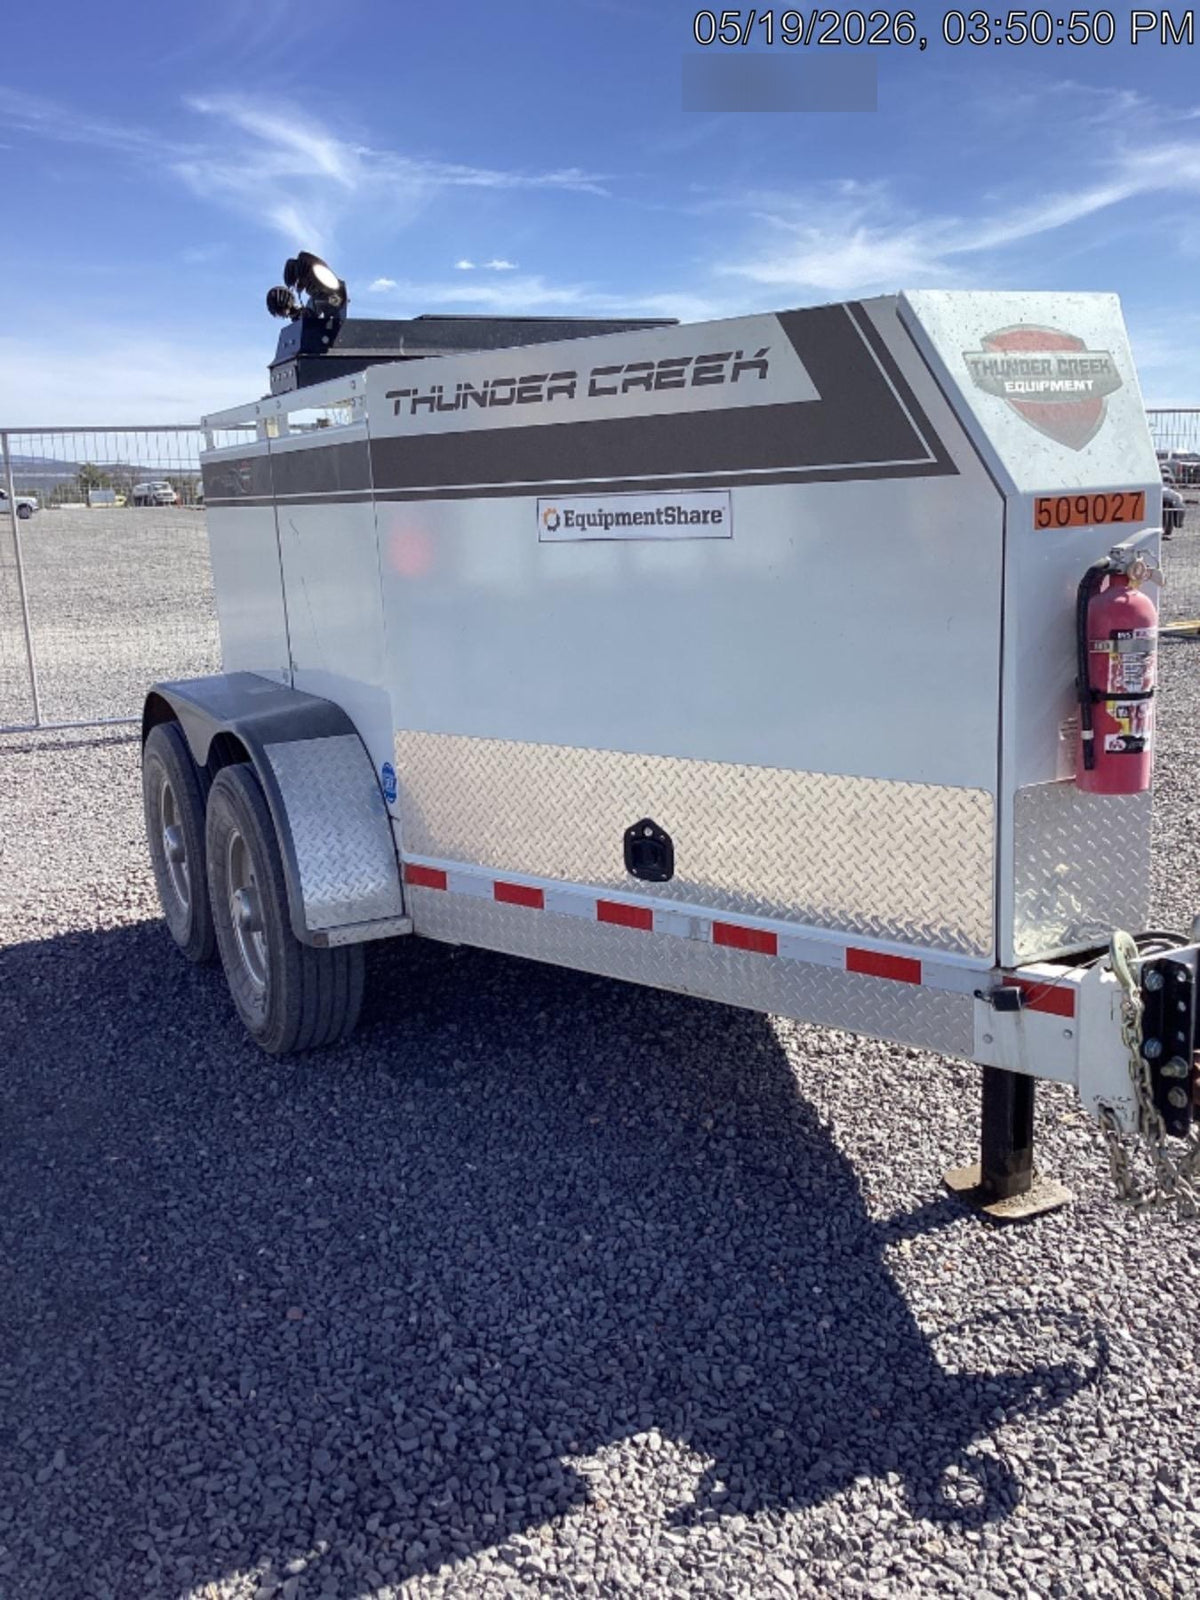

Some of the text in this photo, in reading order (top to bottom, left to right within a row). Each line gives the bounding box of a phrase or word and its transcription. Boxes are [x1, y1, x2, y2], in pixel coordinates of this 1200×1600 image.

[970, 358, 1112, 377] THUNDER CREEK
[386, 347, 771, 416] THUNDER CREEK
[1004, 379, 1094, 393] EQUIPMENT
[563, 506, 723, 531] EquipmentShare
[1037, 492, 1143, 527] 509027
